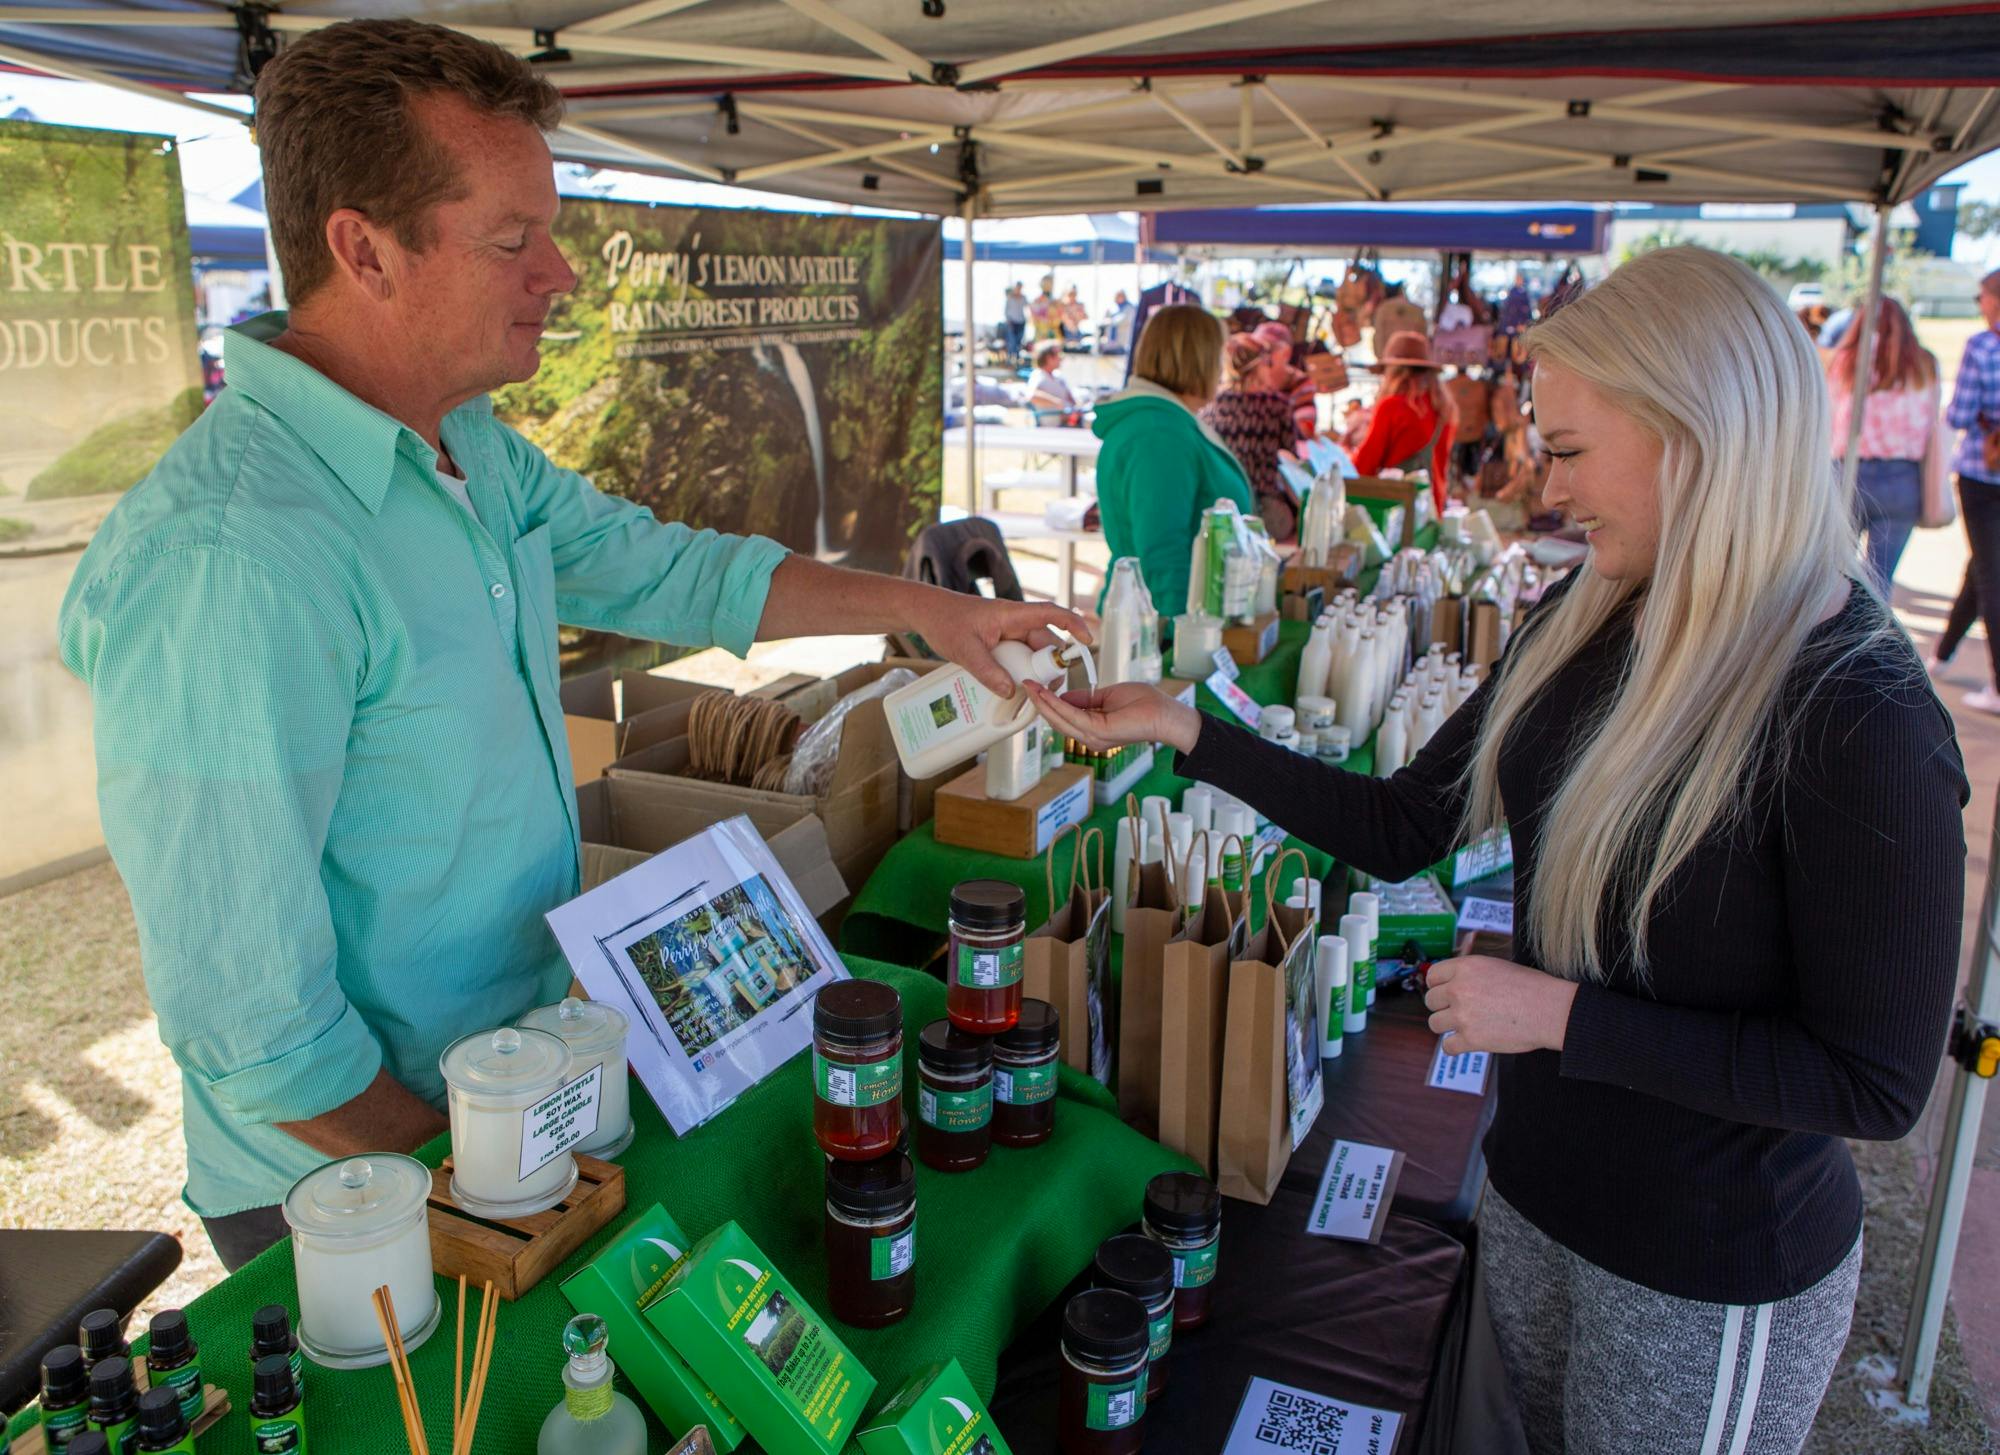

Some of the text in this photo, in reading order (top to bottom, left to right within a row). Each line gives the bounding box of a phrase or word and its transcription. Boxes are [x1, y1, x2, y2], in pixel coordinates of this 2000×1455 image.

[2, 238, 168, 293] RTLE
[602, 230, 859, 312] Perry's LEMON MYRTLE
[610, 295, 860, 333] RAINFOREST PRODUCTS
[660, 932, 710, 969] Perry's
[534, 1073, 595, 1117] LEMON MYRTLE
[546, 1092, 582, 1119] SOY WAX
[533, 1096, 592, 1139] LARGE CANDLE
[555, 1130, 580, 1151] $50.00
[1316, 1203, 1331, 1229] LEMON
[1325, 1175, 1340, 1202] MYRTLE
[1340, 1173, 1355, 1200] SPECIAL
[1362, 1165, 1385, 1219] SAVE SAVE SAVE
[636, 1279, 663, 1307] LEMON
[727, 1269, 772, 1331] LEMON MYRTLE
[745, 1292, 768, 1322] TEA BAGS
[785, 1355, 801, 1376] Makes
[809, 1325, 820, 1340] cups
[956, 1411, 981, 1444] MYRTLE
[1370, 1414, 1382, 1435] me
